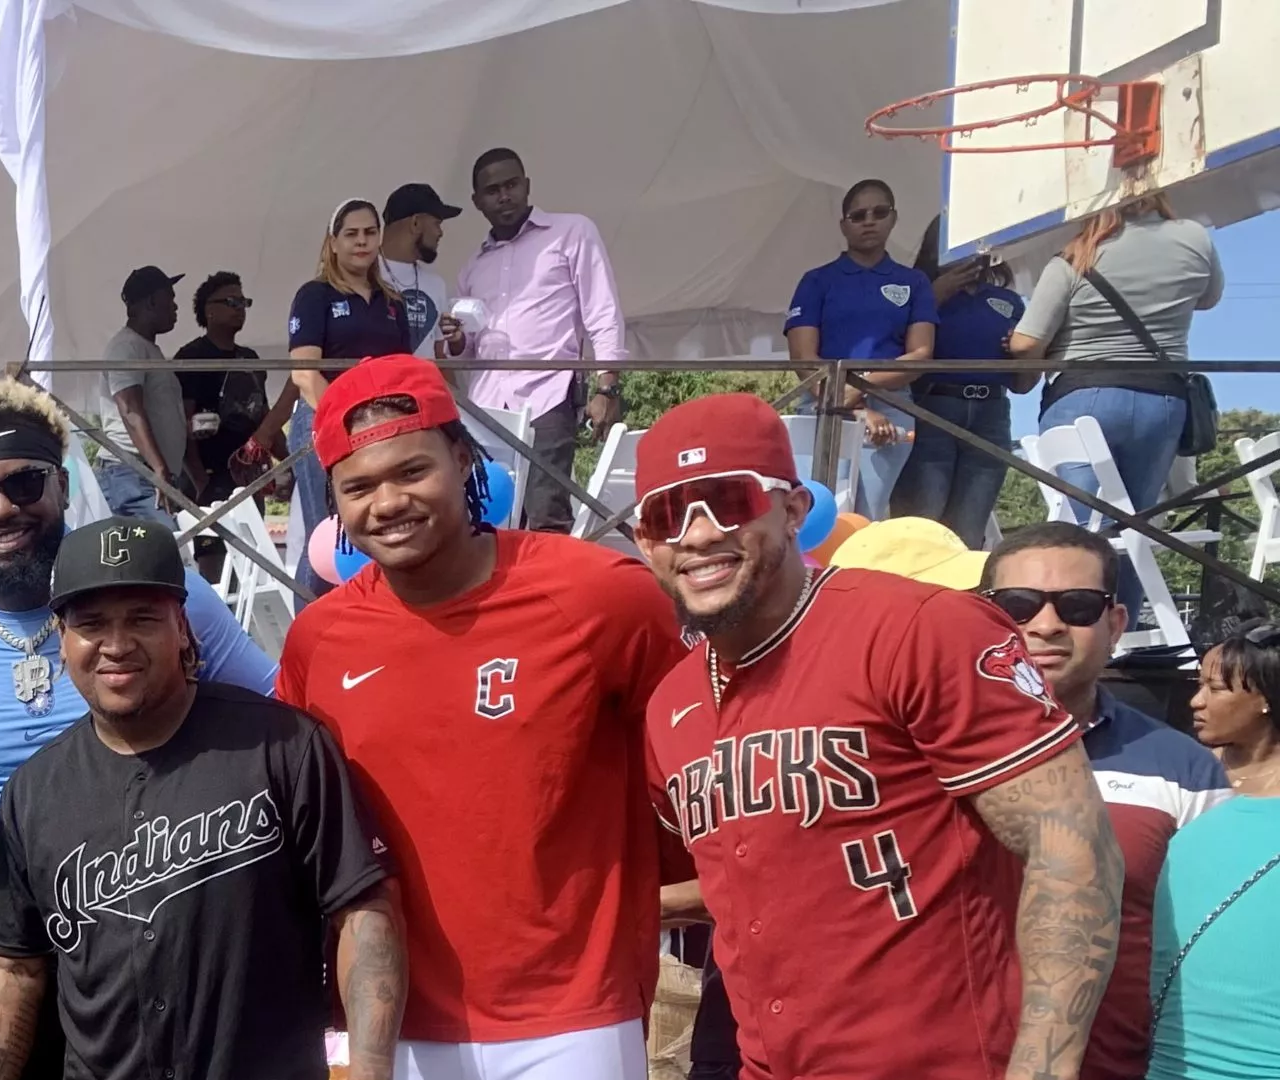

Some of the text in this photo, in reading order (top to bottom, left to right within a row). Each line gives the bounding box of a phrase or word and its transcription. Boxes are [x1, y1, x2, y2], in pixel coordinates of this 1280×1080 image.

[101, 526, 131, 567] C
[475, 658, 519, 719] C
[46, 789, 284, 952] Indians
[841, 829, 919, 922] 4
